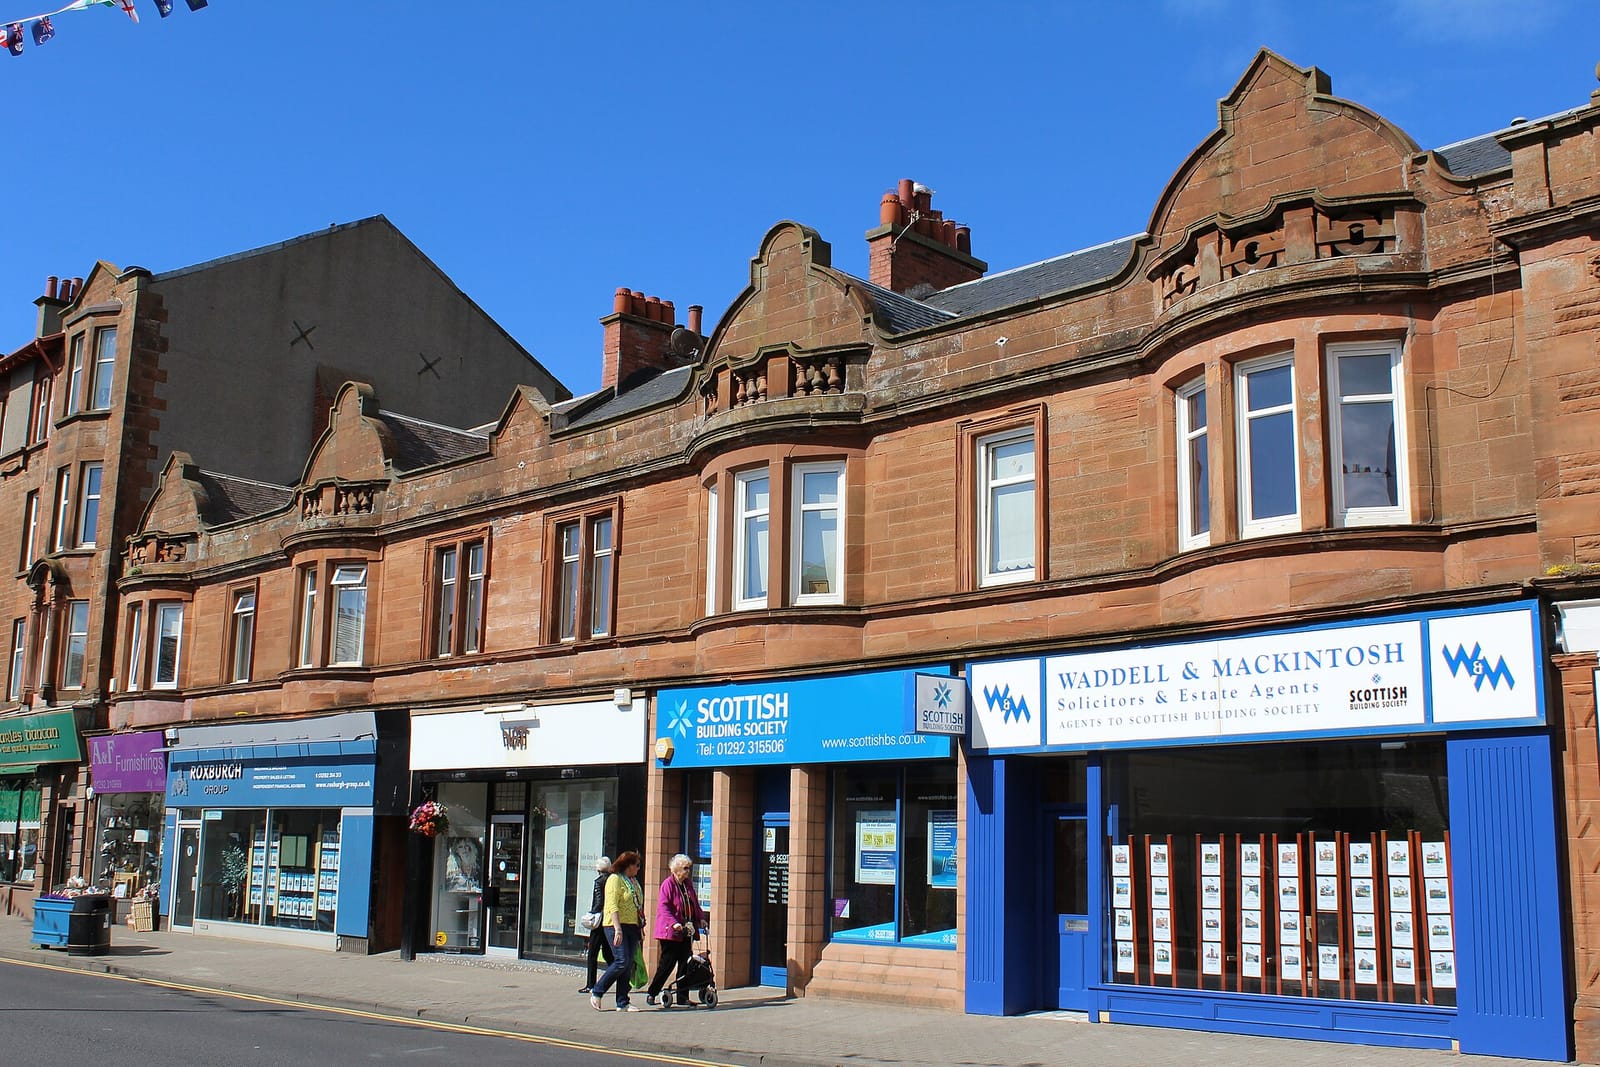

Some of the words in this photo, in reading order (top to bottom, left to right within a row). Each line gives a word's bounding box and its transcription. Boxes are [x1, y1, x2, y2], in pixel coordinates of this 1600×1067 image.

[1058, 664, 1170, 690] WADDELL
[1182, 661, 1200, 680] &
[1212, 642, 1405, 678] MACKINTOSH
[1057, 695, 1145, 711] Solicitors
[1155, 690, 1168, 704] &
[1179, 686, 1238, 702] Estate
[1249, 682, 1319, 699] Agents
[1349, 686, 1408, 703] SCOTTISH
[696, 692, 789, 723] SCOTTISH
[1349, 702, 1380, 710] BUILDING
[1382, 700, 1408, 708] SOCIETY
[922, 710, 963, 725] SCOTTISH
[1059, 718, 1102, 729] AGENTS
[1108, 717, 1123, 726] TO
[1129, 712, 1188, 725] SCOTTISH
[1194, 707, 1257, 721] BUILDING
[1264, 703, 1320, 716] SOCIETY
[696, 723, 742, 739] BUILDING
[743, 720, 788, 736] SOCIETY
[922, 722, 943, 731] BUILDING
[944, 724, 963, 732] SOCIETY
[699, 743, 715, 756] Tel:
[716, 741, 746, 755] 01292
[747, 739, 785, 754] 315506
[821, 733, 926, 749] www.scottishbs.co.uk
[92, 740, 115, 764] A&F
[115, 753, 164, 775] Furnishings
[190, 763, 243, 780] ROXBURGH
[204, 785, 230, 795] GROUP
